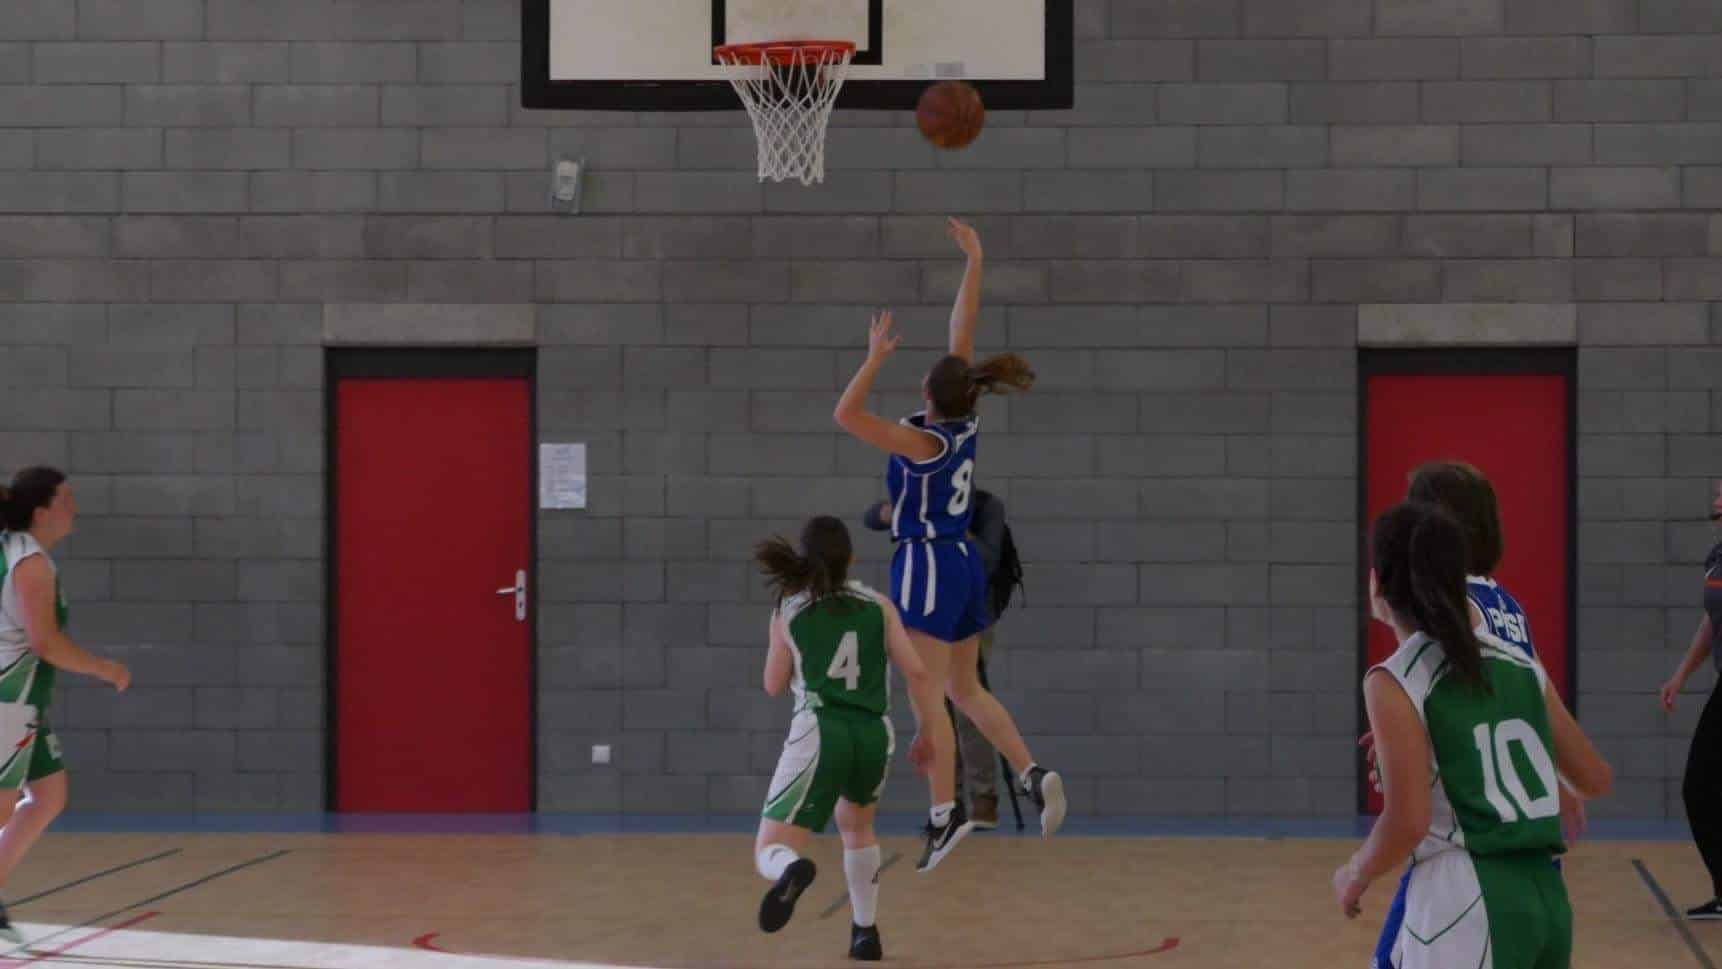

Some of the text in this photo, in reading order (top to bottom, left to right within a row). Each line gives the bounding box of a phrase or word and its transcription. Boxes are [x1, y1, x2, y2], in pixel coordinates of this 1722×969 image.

[947, 458, 974, 516] 8
[826, 631, 861, 690] 4
[1473, 718, 1560, 823] 10
